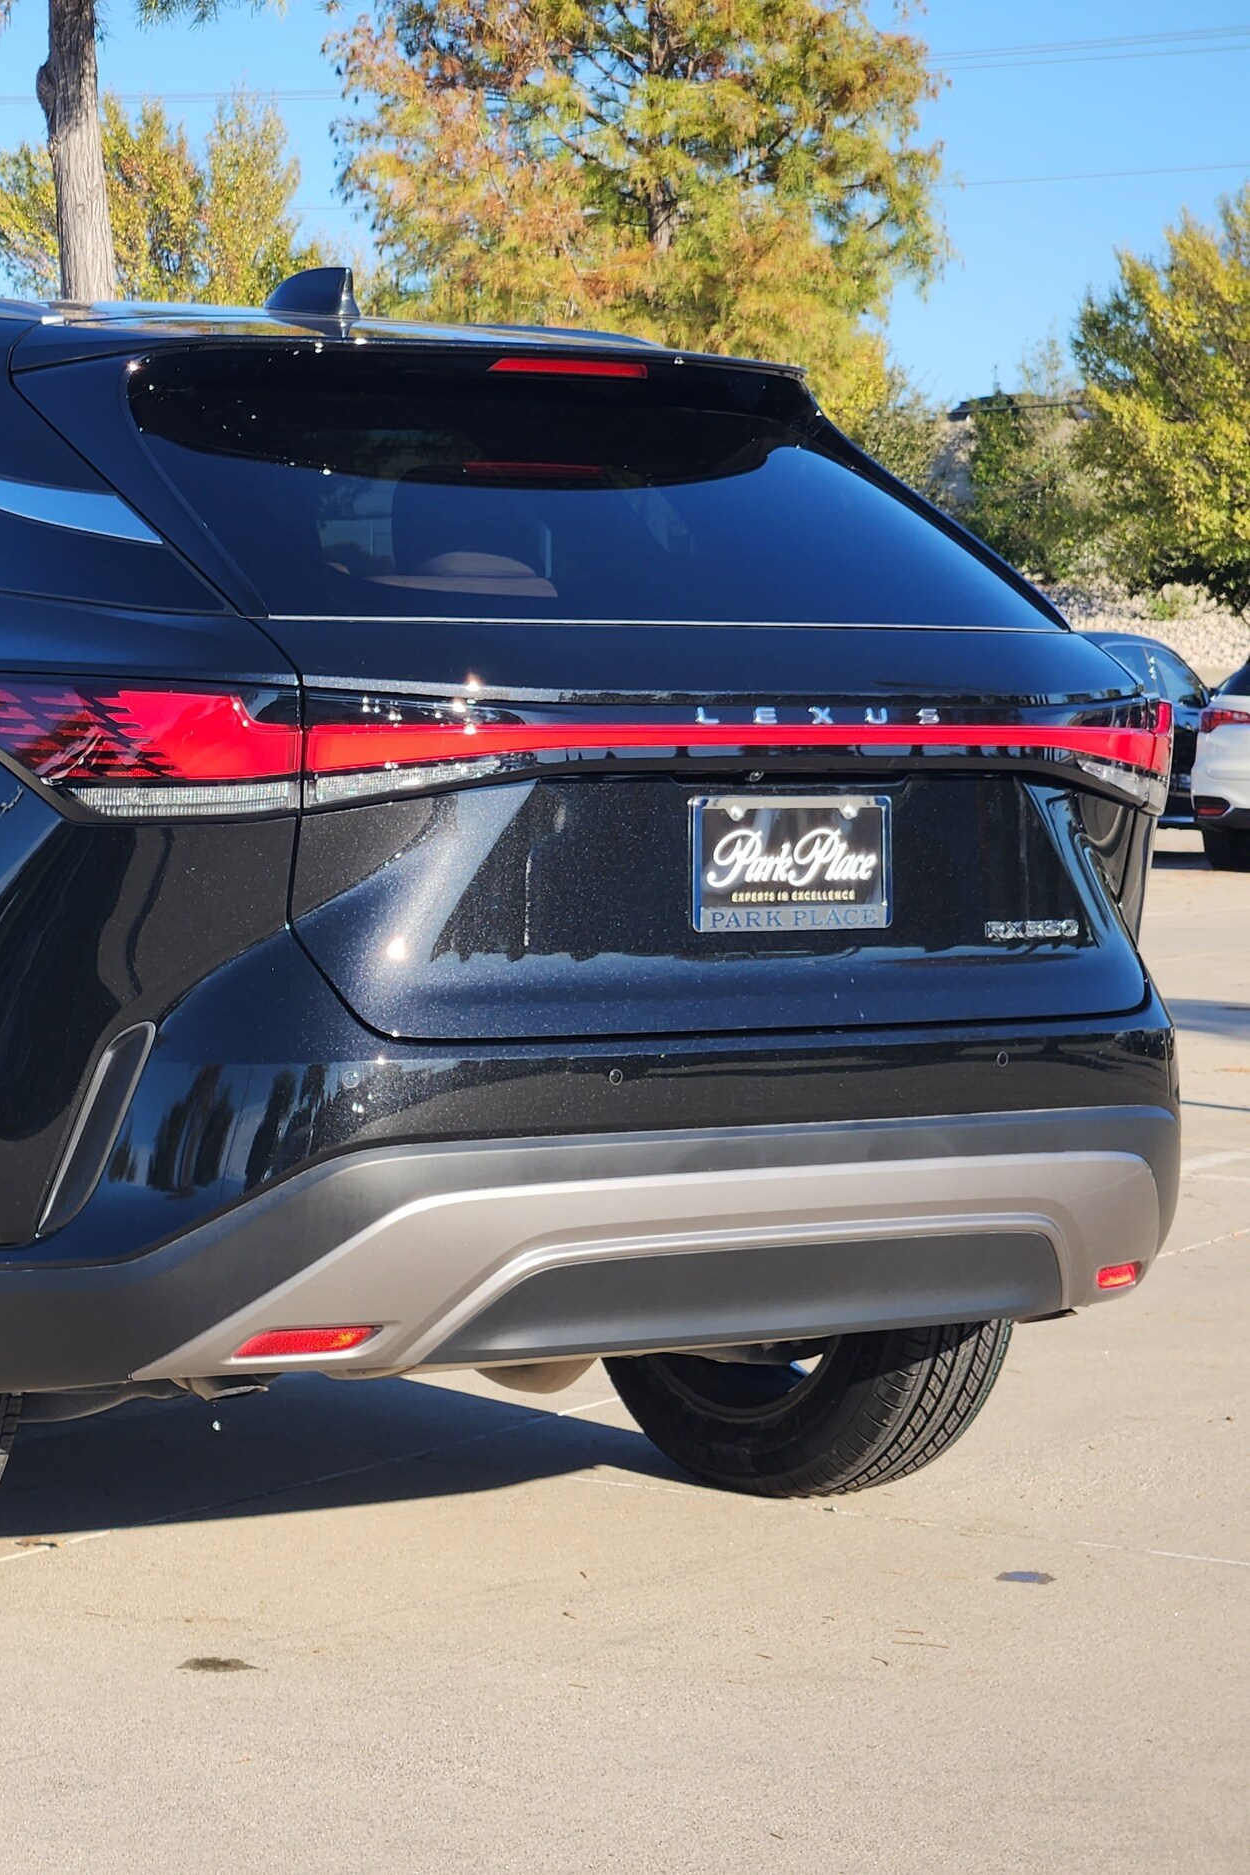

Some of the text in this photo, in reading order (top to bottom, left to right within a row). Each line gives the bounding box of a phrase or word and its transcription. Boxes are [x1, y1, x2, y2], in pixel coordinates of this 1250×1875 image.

[695, 706, 940, 725] LEXUS
[706, 827, 878, 888] Park Place
[731, 890, 856, 903] EXPERTS IN EXCELLENCE
[709, 908, 878, 929] PARK PLACE
